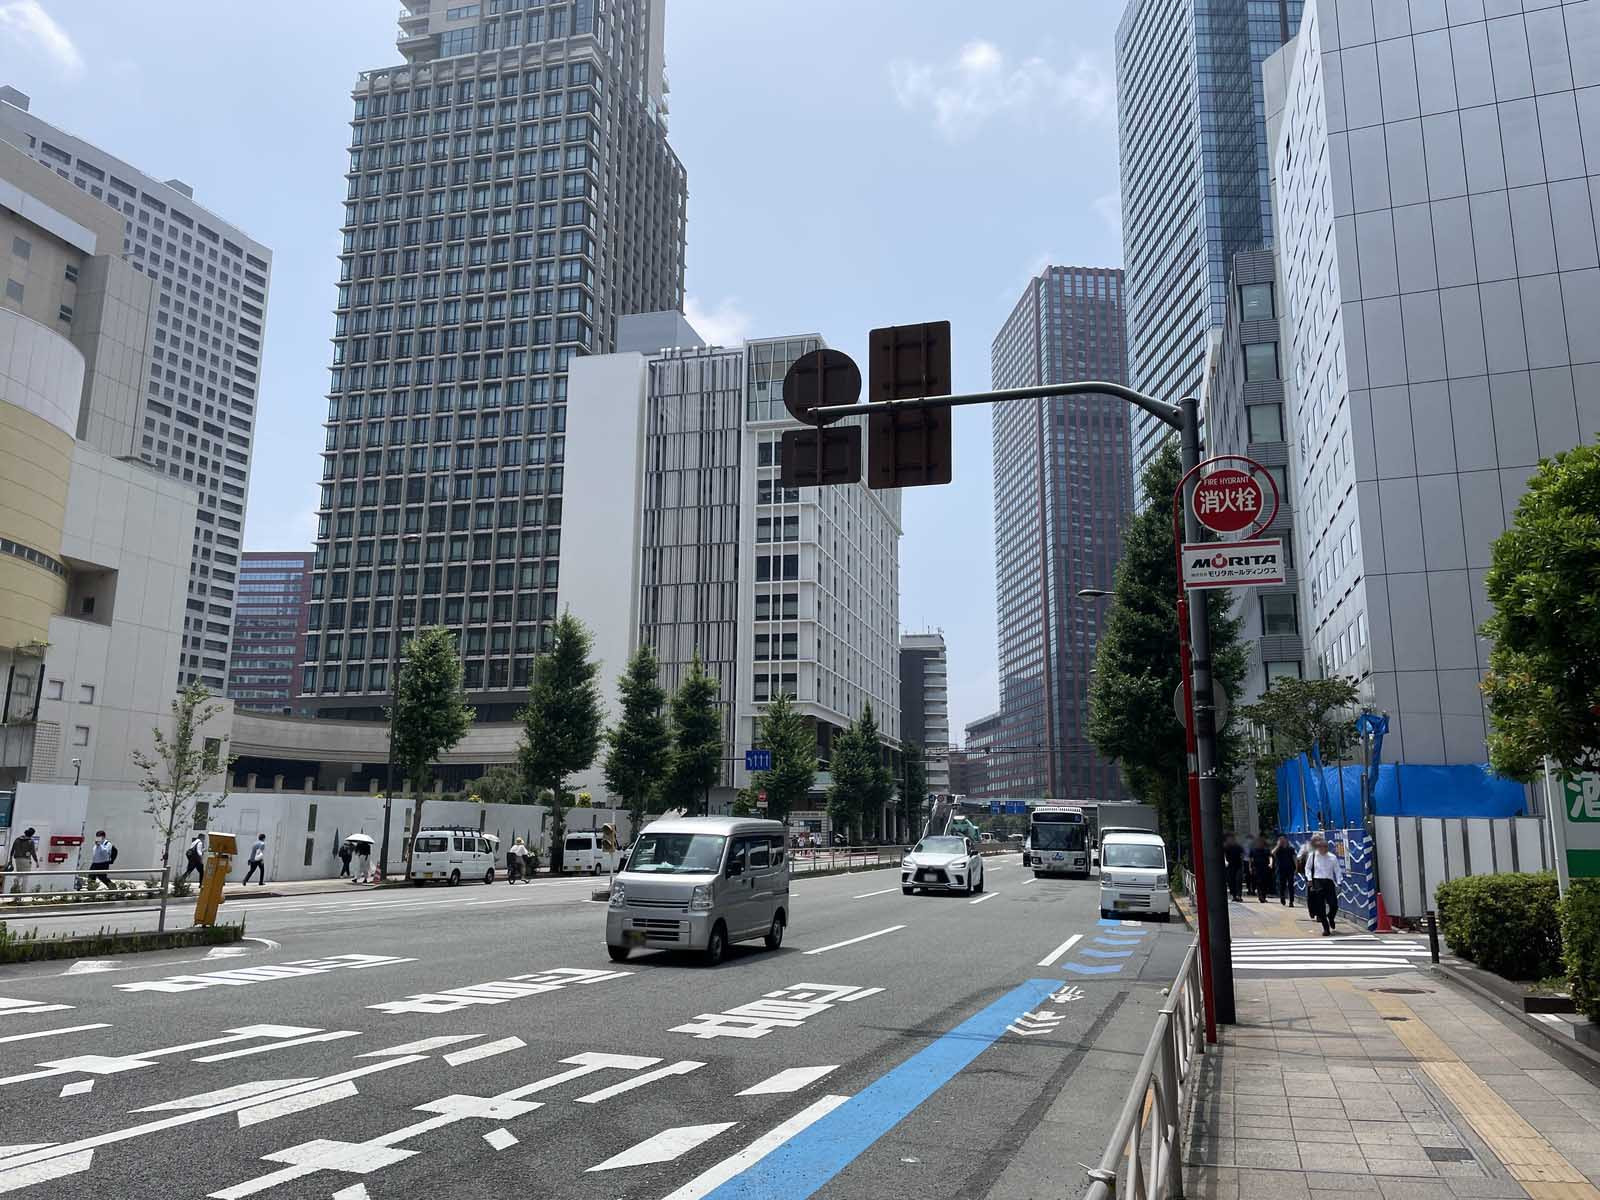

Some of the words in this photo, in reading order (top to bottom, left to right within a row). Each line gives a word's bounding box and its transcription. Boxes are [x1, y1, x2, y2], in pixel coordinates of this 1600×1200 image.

[1203, 478, 1218, 486] FIRE
[1219, 477, 1249, 485] HYDRANT
[1200, 488, 1256, 513] 消火栓
[1192, 554, 1276, 568] MORITA
